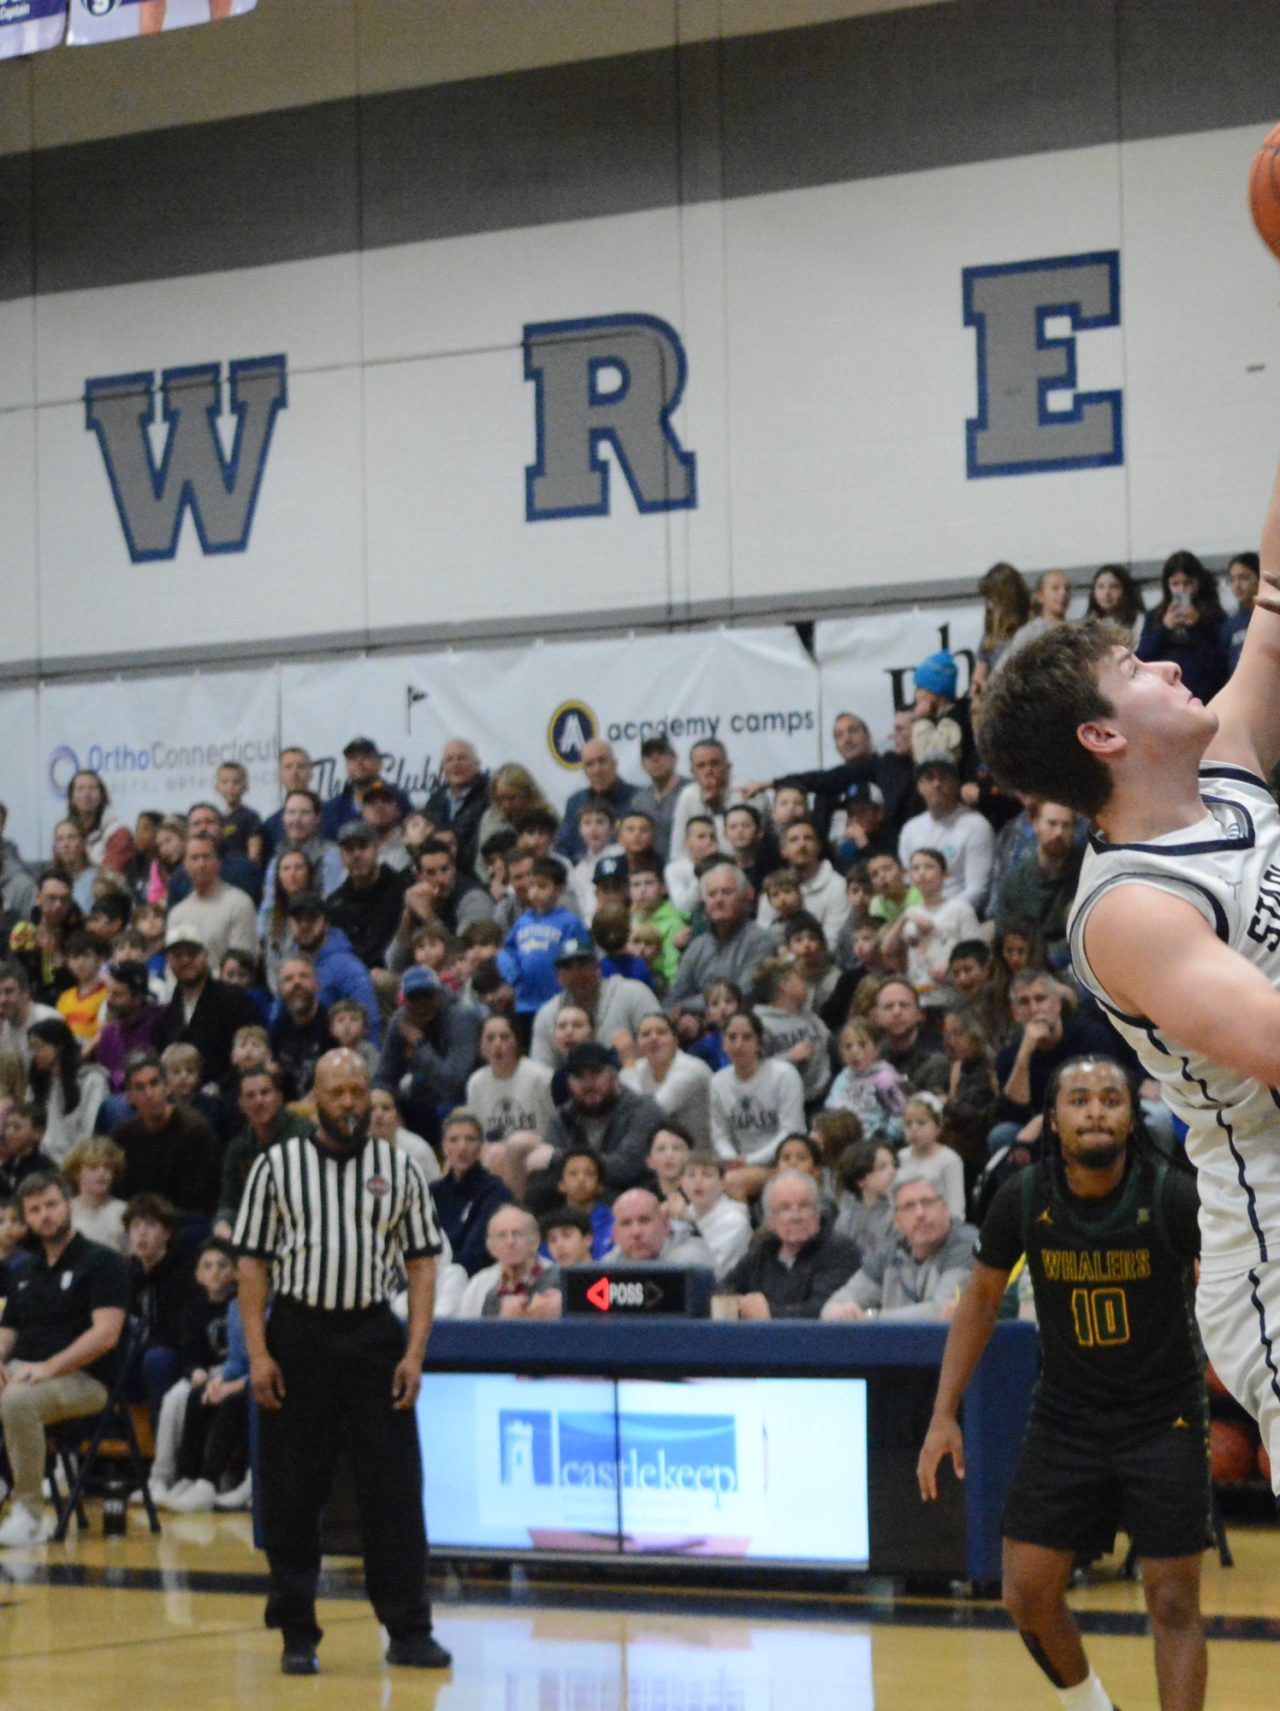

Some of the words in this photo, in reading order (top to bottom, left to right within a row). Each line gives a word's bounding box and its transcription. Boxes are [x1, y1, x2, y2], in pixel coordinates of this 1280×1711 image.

[607, 715, 721, 742] academy
[730, 710, 815, 736] camps
[1041, 1249, 1151, 1282] WHALERS
[609, 1282, 645, 1307] POSS
[1071, 1287, 1131, 1348] 10
[561, 1448, 736, 1509] castlekeep
